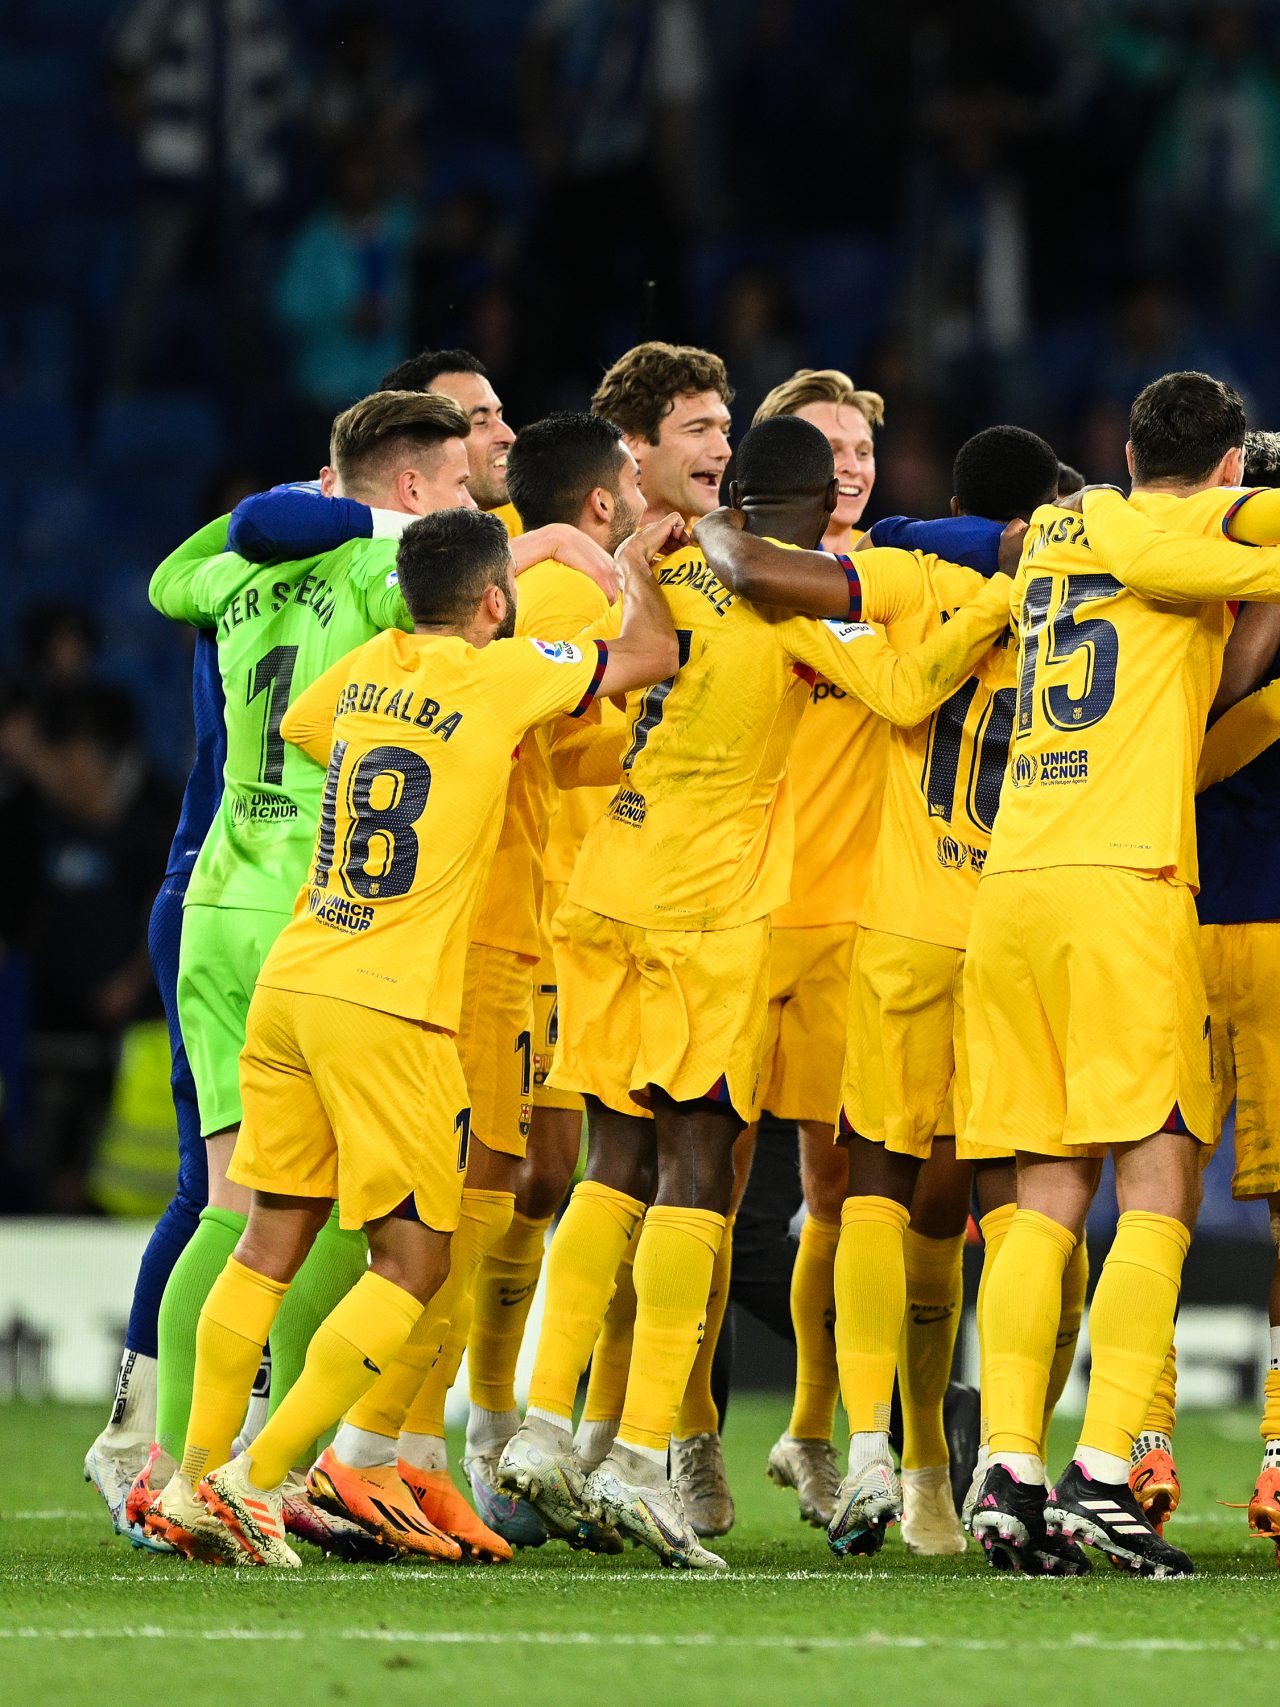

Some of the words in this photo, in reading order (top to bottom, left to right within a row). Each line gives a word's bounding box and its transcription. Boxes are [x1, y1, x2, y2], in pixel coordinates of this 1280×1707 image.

[1016, 573, 1126, 740] 15
[246, 645, 299, 786] 1
[333, 683, 388, 727] ORDI
[384, 688, 464, 742] ALBA
[1040, 750, 1088, 767] UNHCR
[1040, 763, 1088, 780] ACNUR
[250, 805, 298, 818] ACNUR
[312, 740, 432, 899] 18
[317, 905, 371, 932] ACNUR
[325, 894, 375, 920] UNHCR
